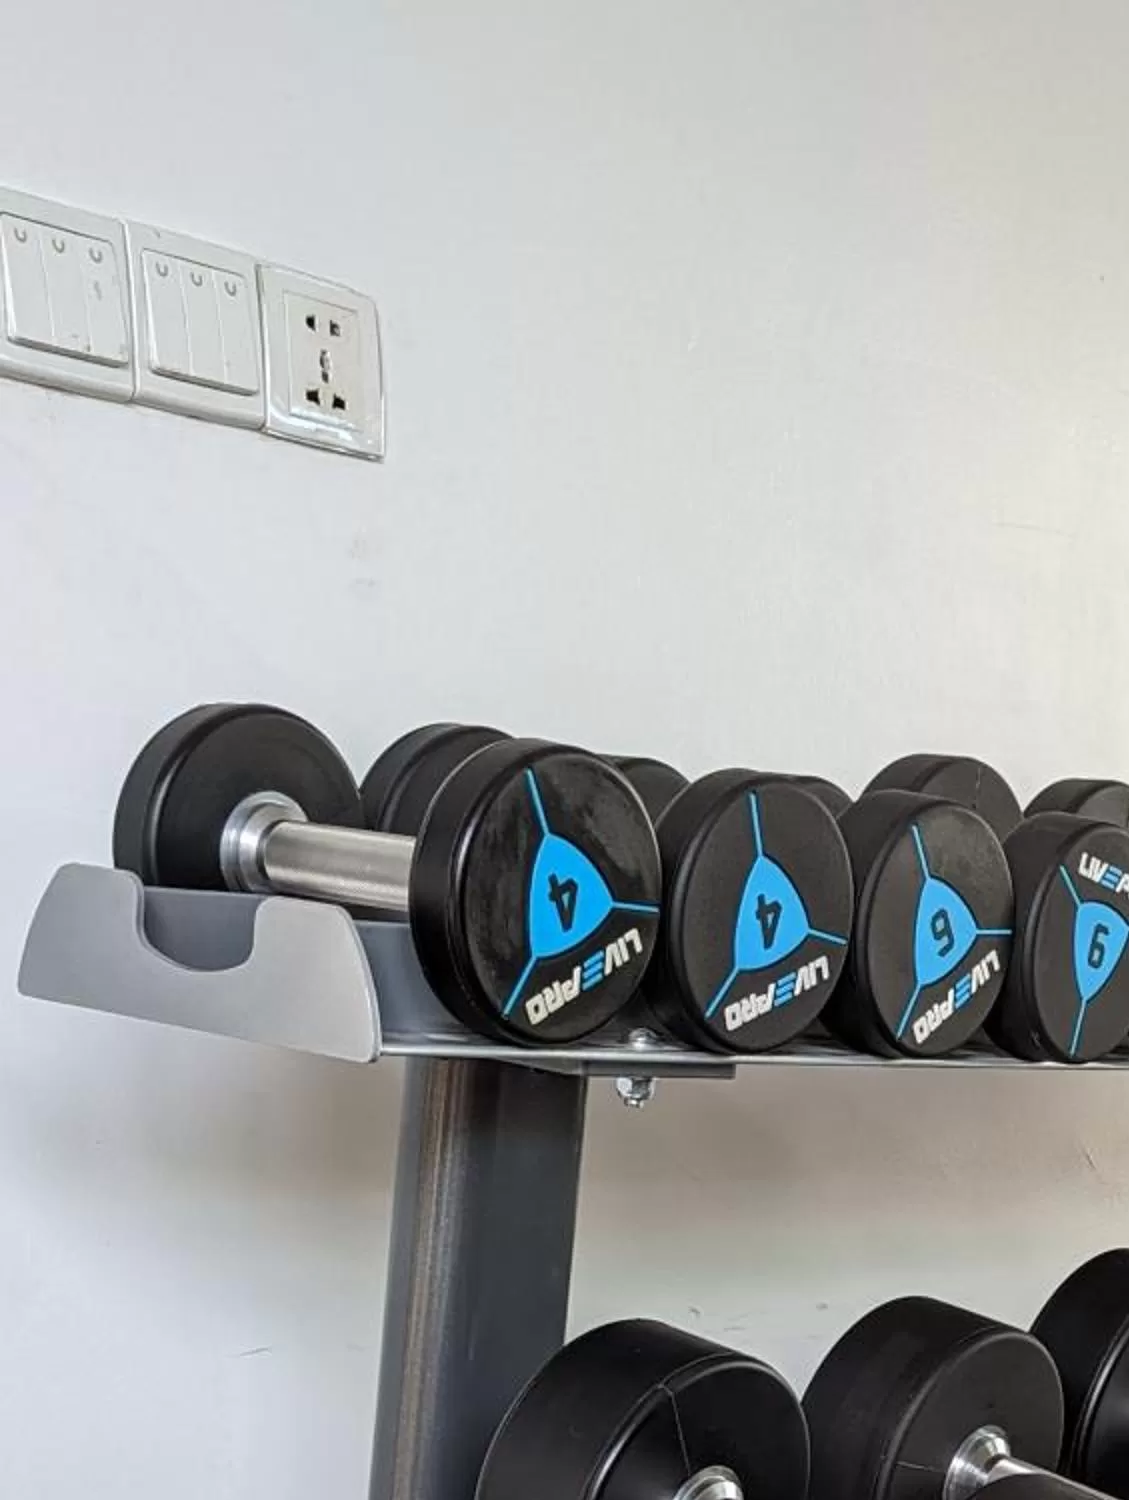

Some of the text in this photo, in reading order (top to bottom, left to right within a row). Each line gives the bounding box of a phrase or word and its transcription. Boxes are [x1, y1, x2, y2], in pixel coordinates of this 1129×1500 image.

[549, 874, 578, 931] 4
[756, 893, 782, 949] 4
[524, 928, 643, 1025] LIVEPRO
[1088, 923, 1109, 969] 6
[724, 955, 831, 1031] LIVEPRO
[912, 949, 1000, 1044] LIVEPRO
